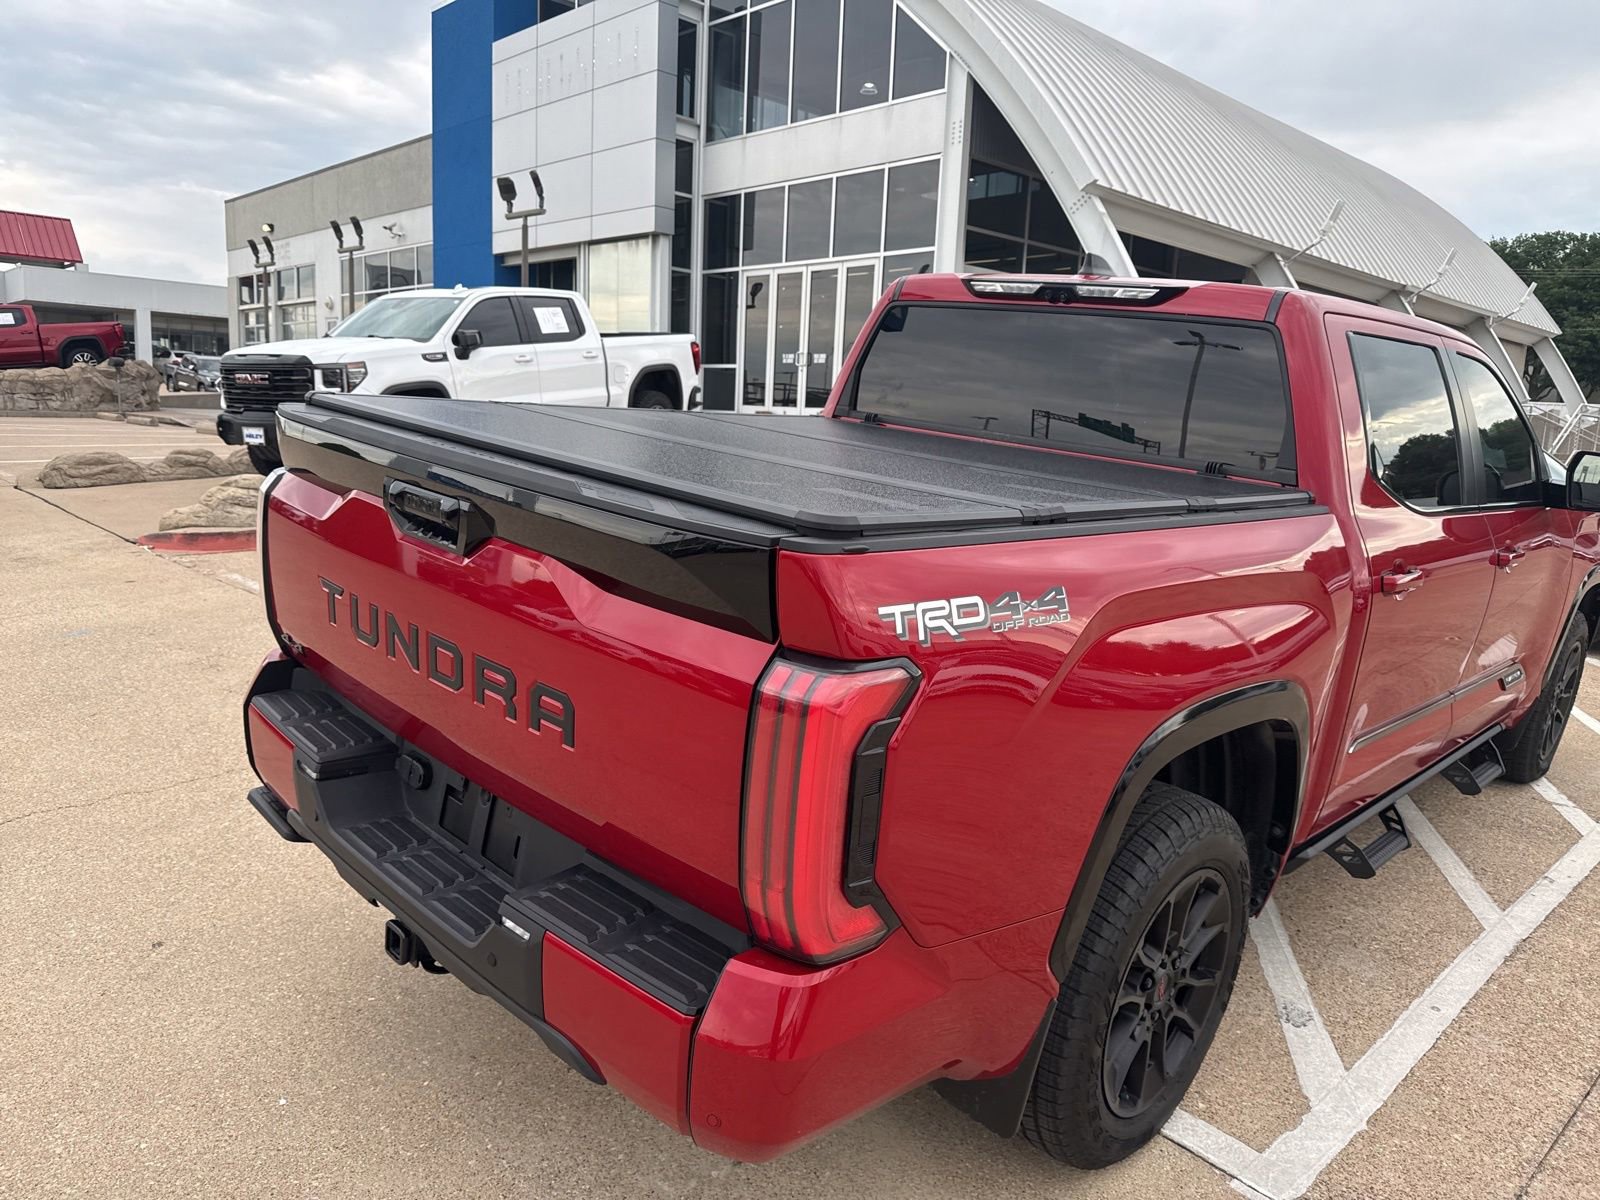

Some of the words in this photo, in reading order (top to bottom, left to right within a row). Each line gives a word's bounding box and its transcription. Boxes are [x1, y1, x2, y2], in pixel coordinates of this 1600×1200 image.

[877, 594, 990, 648] TRD
[992, 618, 1025, 633] OFF
[1028, 612, 1071, 628] ROAD
[318, 574, 576, 752] TUNDRA
